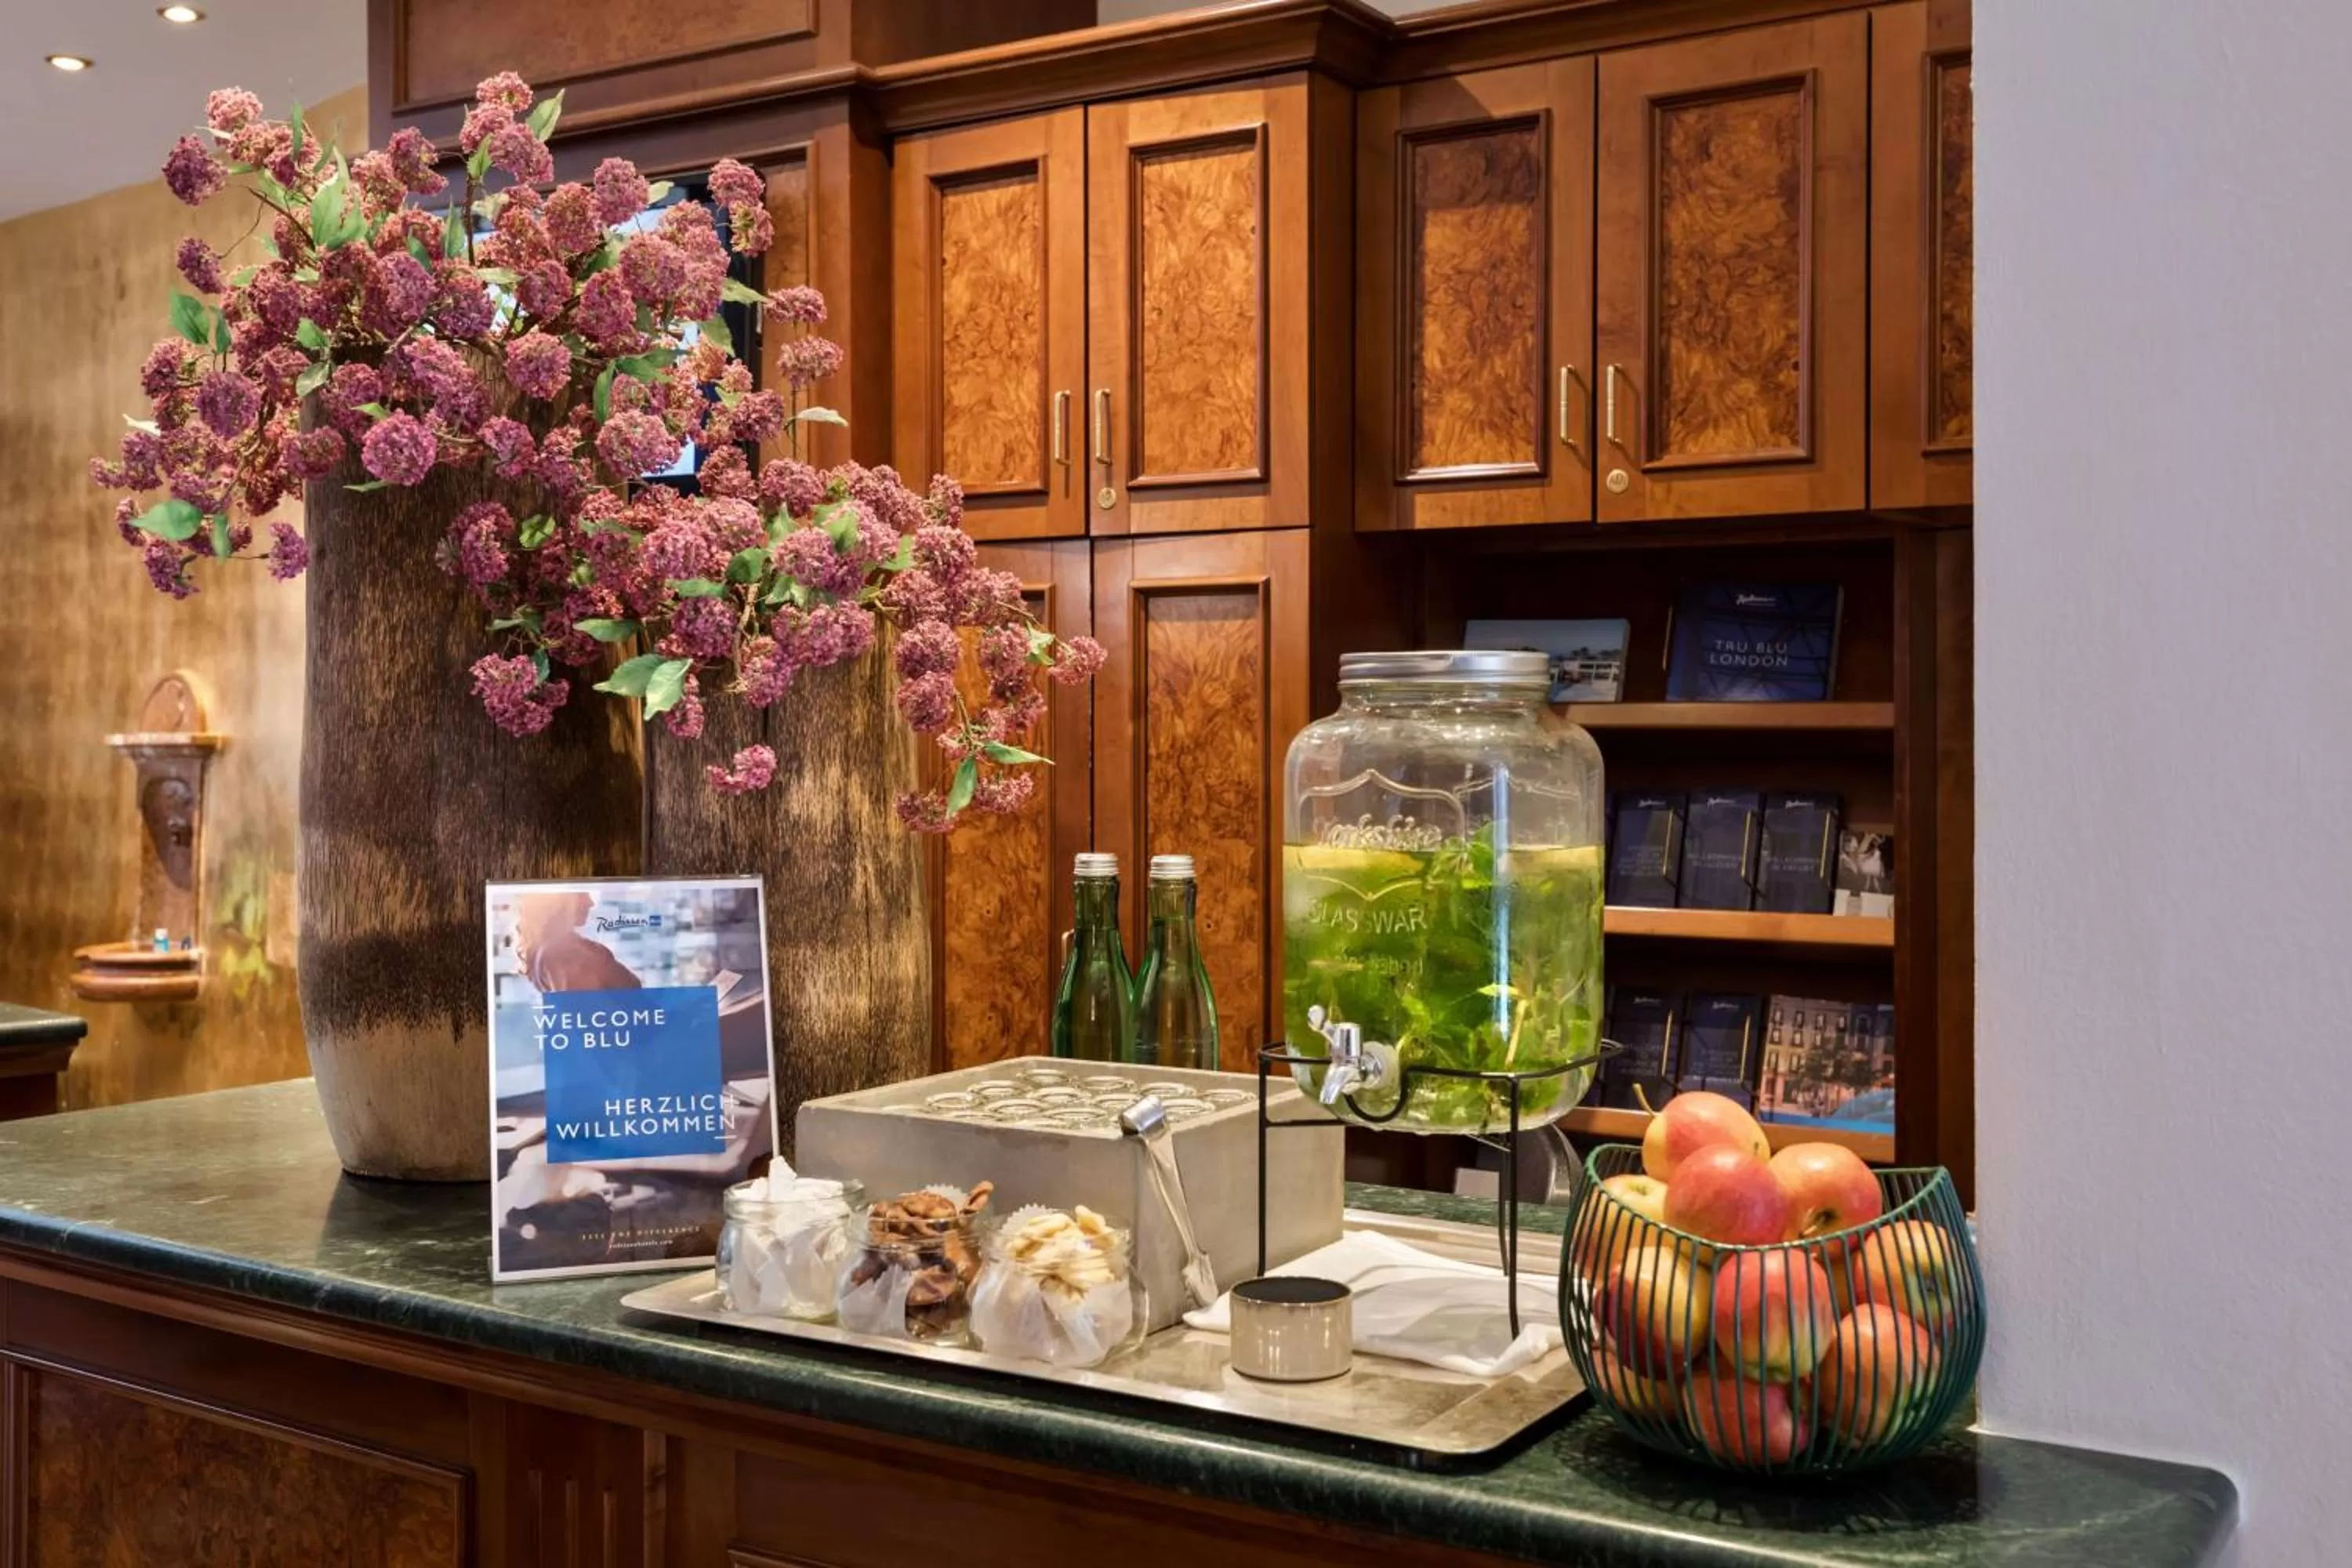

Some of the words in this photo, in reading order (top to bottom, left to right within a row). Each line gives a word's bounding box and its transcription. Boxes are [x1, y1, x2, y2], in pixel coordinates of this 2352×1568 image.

[1709, 652, 1788, 667] LONDON
[532, 1008, 666, 1030] WELCOME
[532, 1033, 569, 1051] TO
[583, 1030, 630, 1049] BLU
[604, 1094, 735, 1116] HERZLICH
[555, 1114, 735, 1140] WILLKOMMEN
